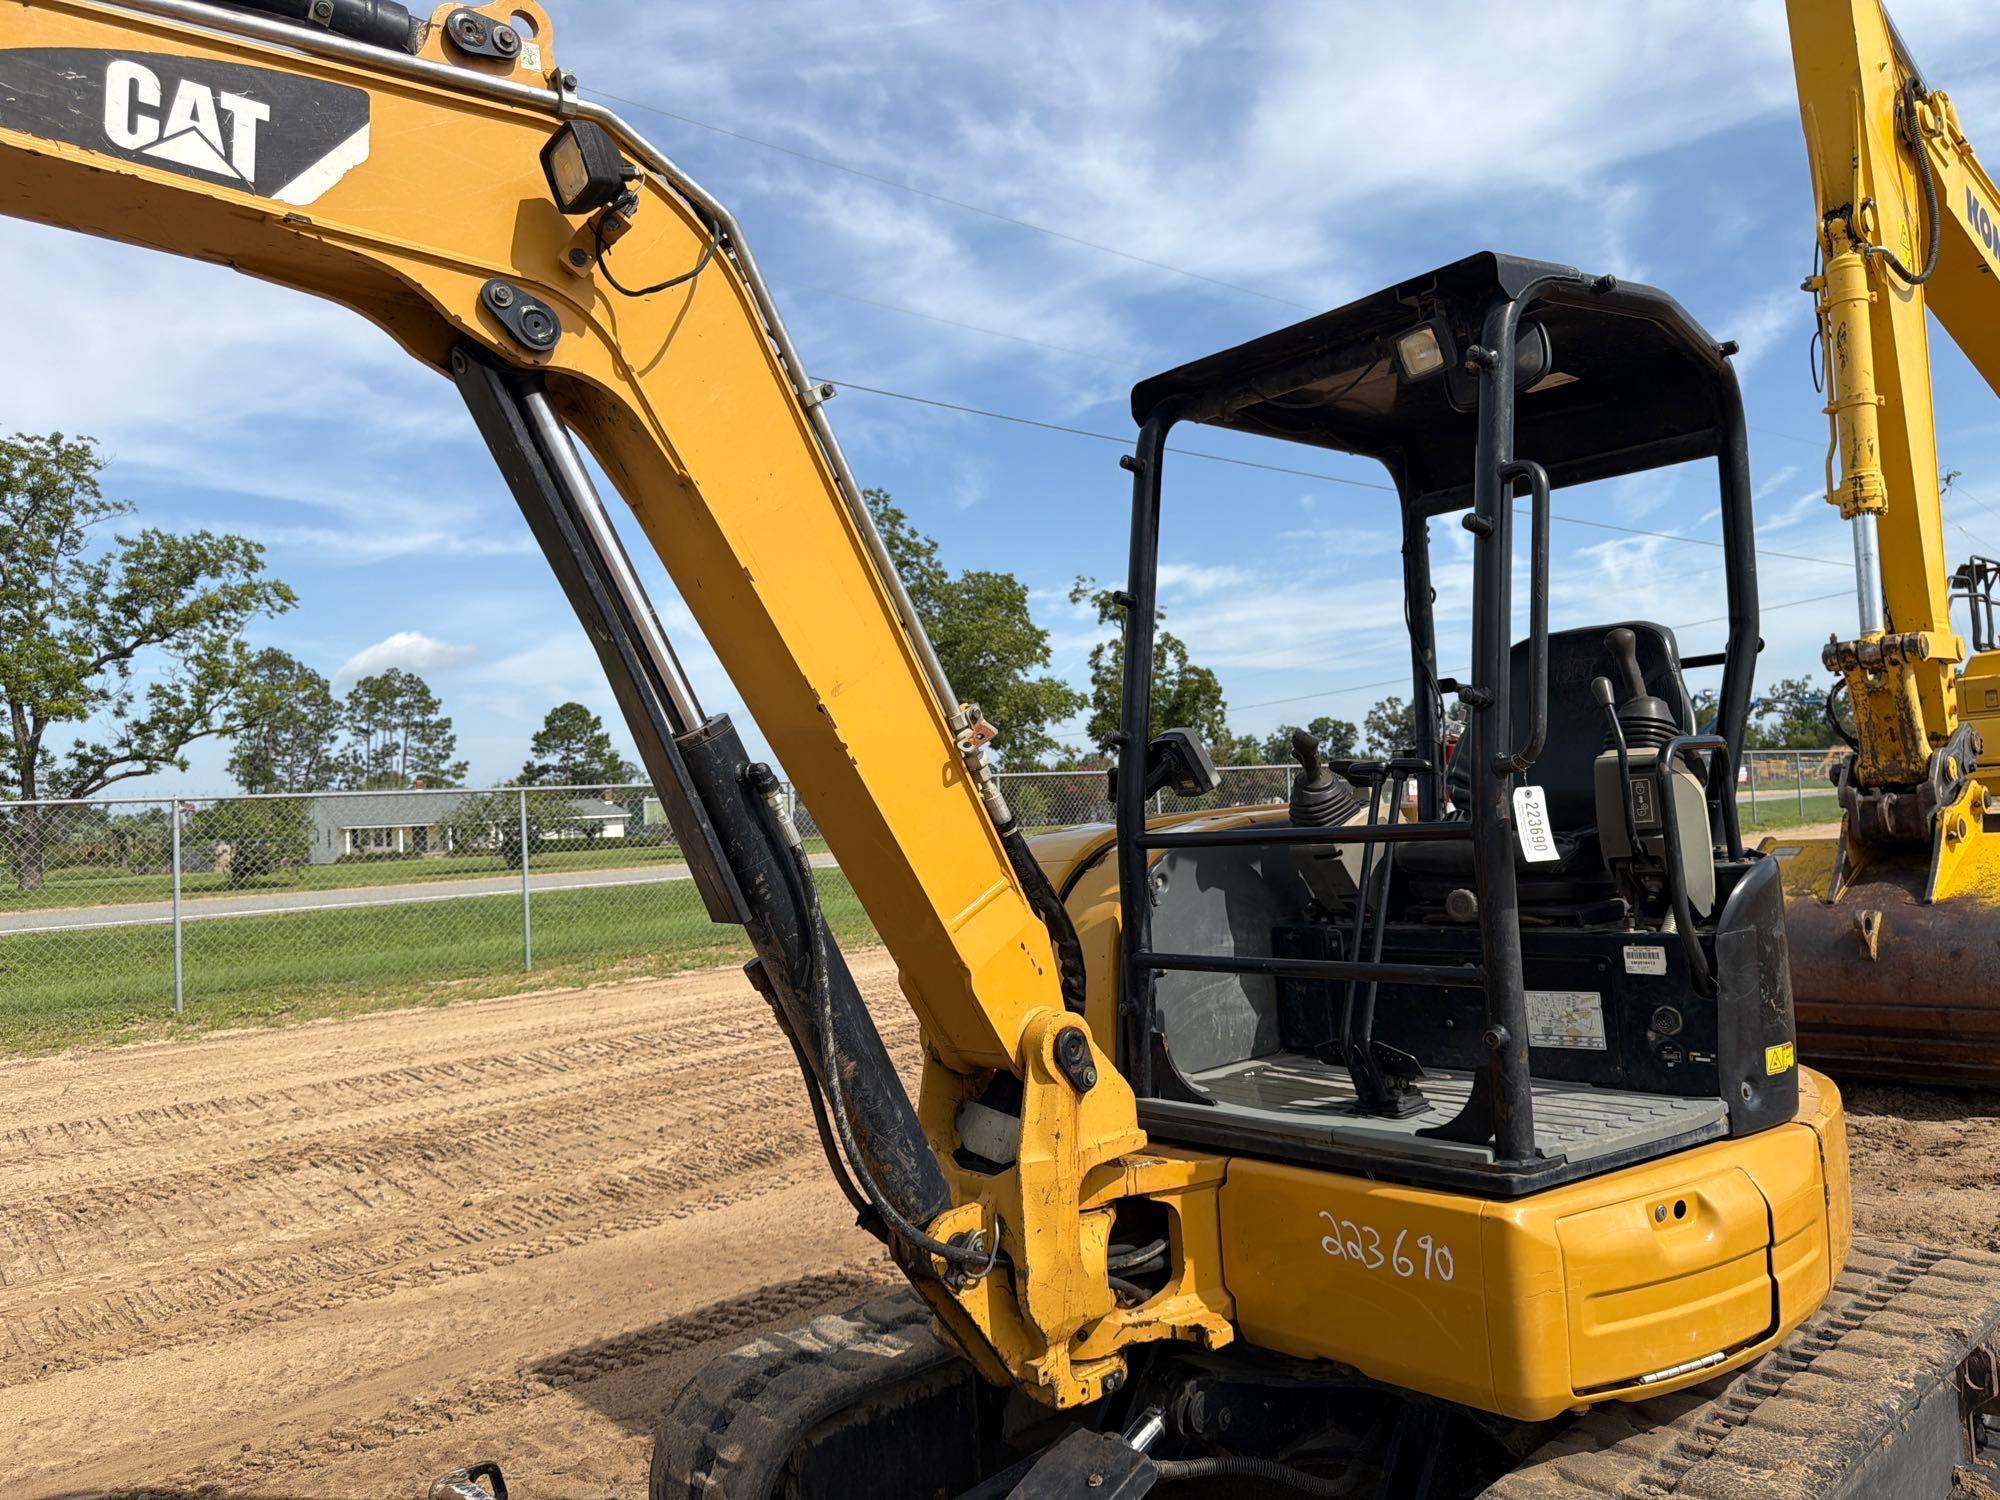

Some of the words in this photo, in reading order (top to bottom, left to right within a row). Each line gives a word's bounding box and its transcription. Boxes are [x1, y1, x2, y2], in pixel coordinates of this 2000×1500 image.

[104, 60, 270, 183] CAT
[1526, 802, 1548, 852] 223690
[1319, 1210, 1454, 1281] 223690
